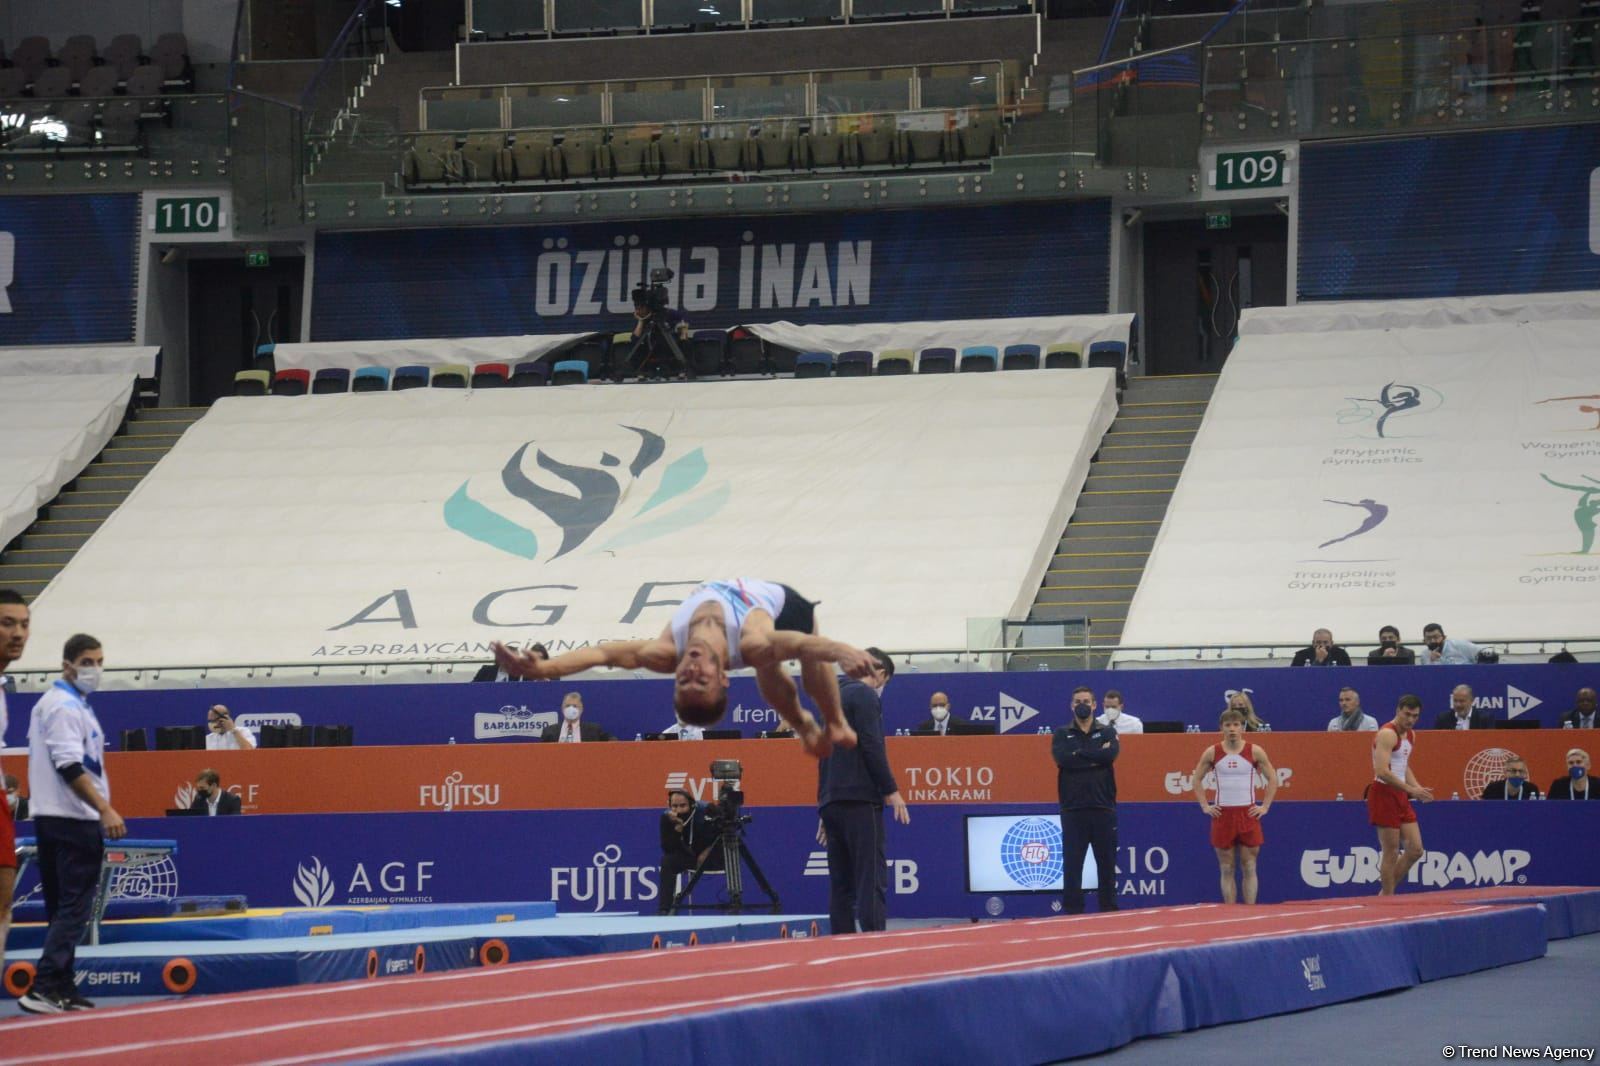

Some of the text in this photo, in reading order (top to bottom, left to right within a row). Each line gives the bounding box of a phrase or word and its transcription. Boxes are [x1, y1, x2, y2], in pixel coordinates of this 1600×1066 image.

[1221, 155, 1278, 185] 109
[161, 201, 214, 228] 110
[535, 230, 872, 317] ÖZÜNƏ İNAN
[1333, 448, 1417, 457] Rhythmic
[1544, 449, 1600, 460] Gymn
[1321, 457, 1424, 466] Gymnastics
[1295, 570, 1397, 580] Trampoline
[1518, 575, 1600, 585] Gymnas
[1287, 580, 1396, 590] Gymnastics
[733, 703, 777, 723] tren
[1001, 706, 1025, 720] TV
[905, 766, 994, 786] TOKIO
[419, 771, 500, 811] FUJITSU
[908, 789, 991, 801] INKARAMI
[348, 861, 434, 893] AGF
[551, 844, 668, 912] FUJITS
[88, 971, 141, 985] SPIETH
